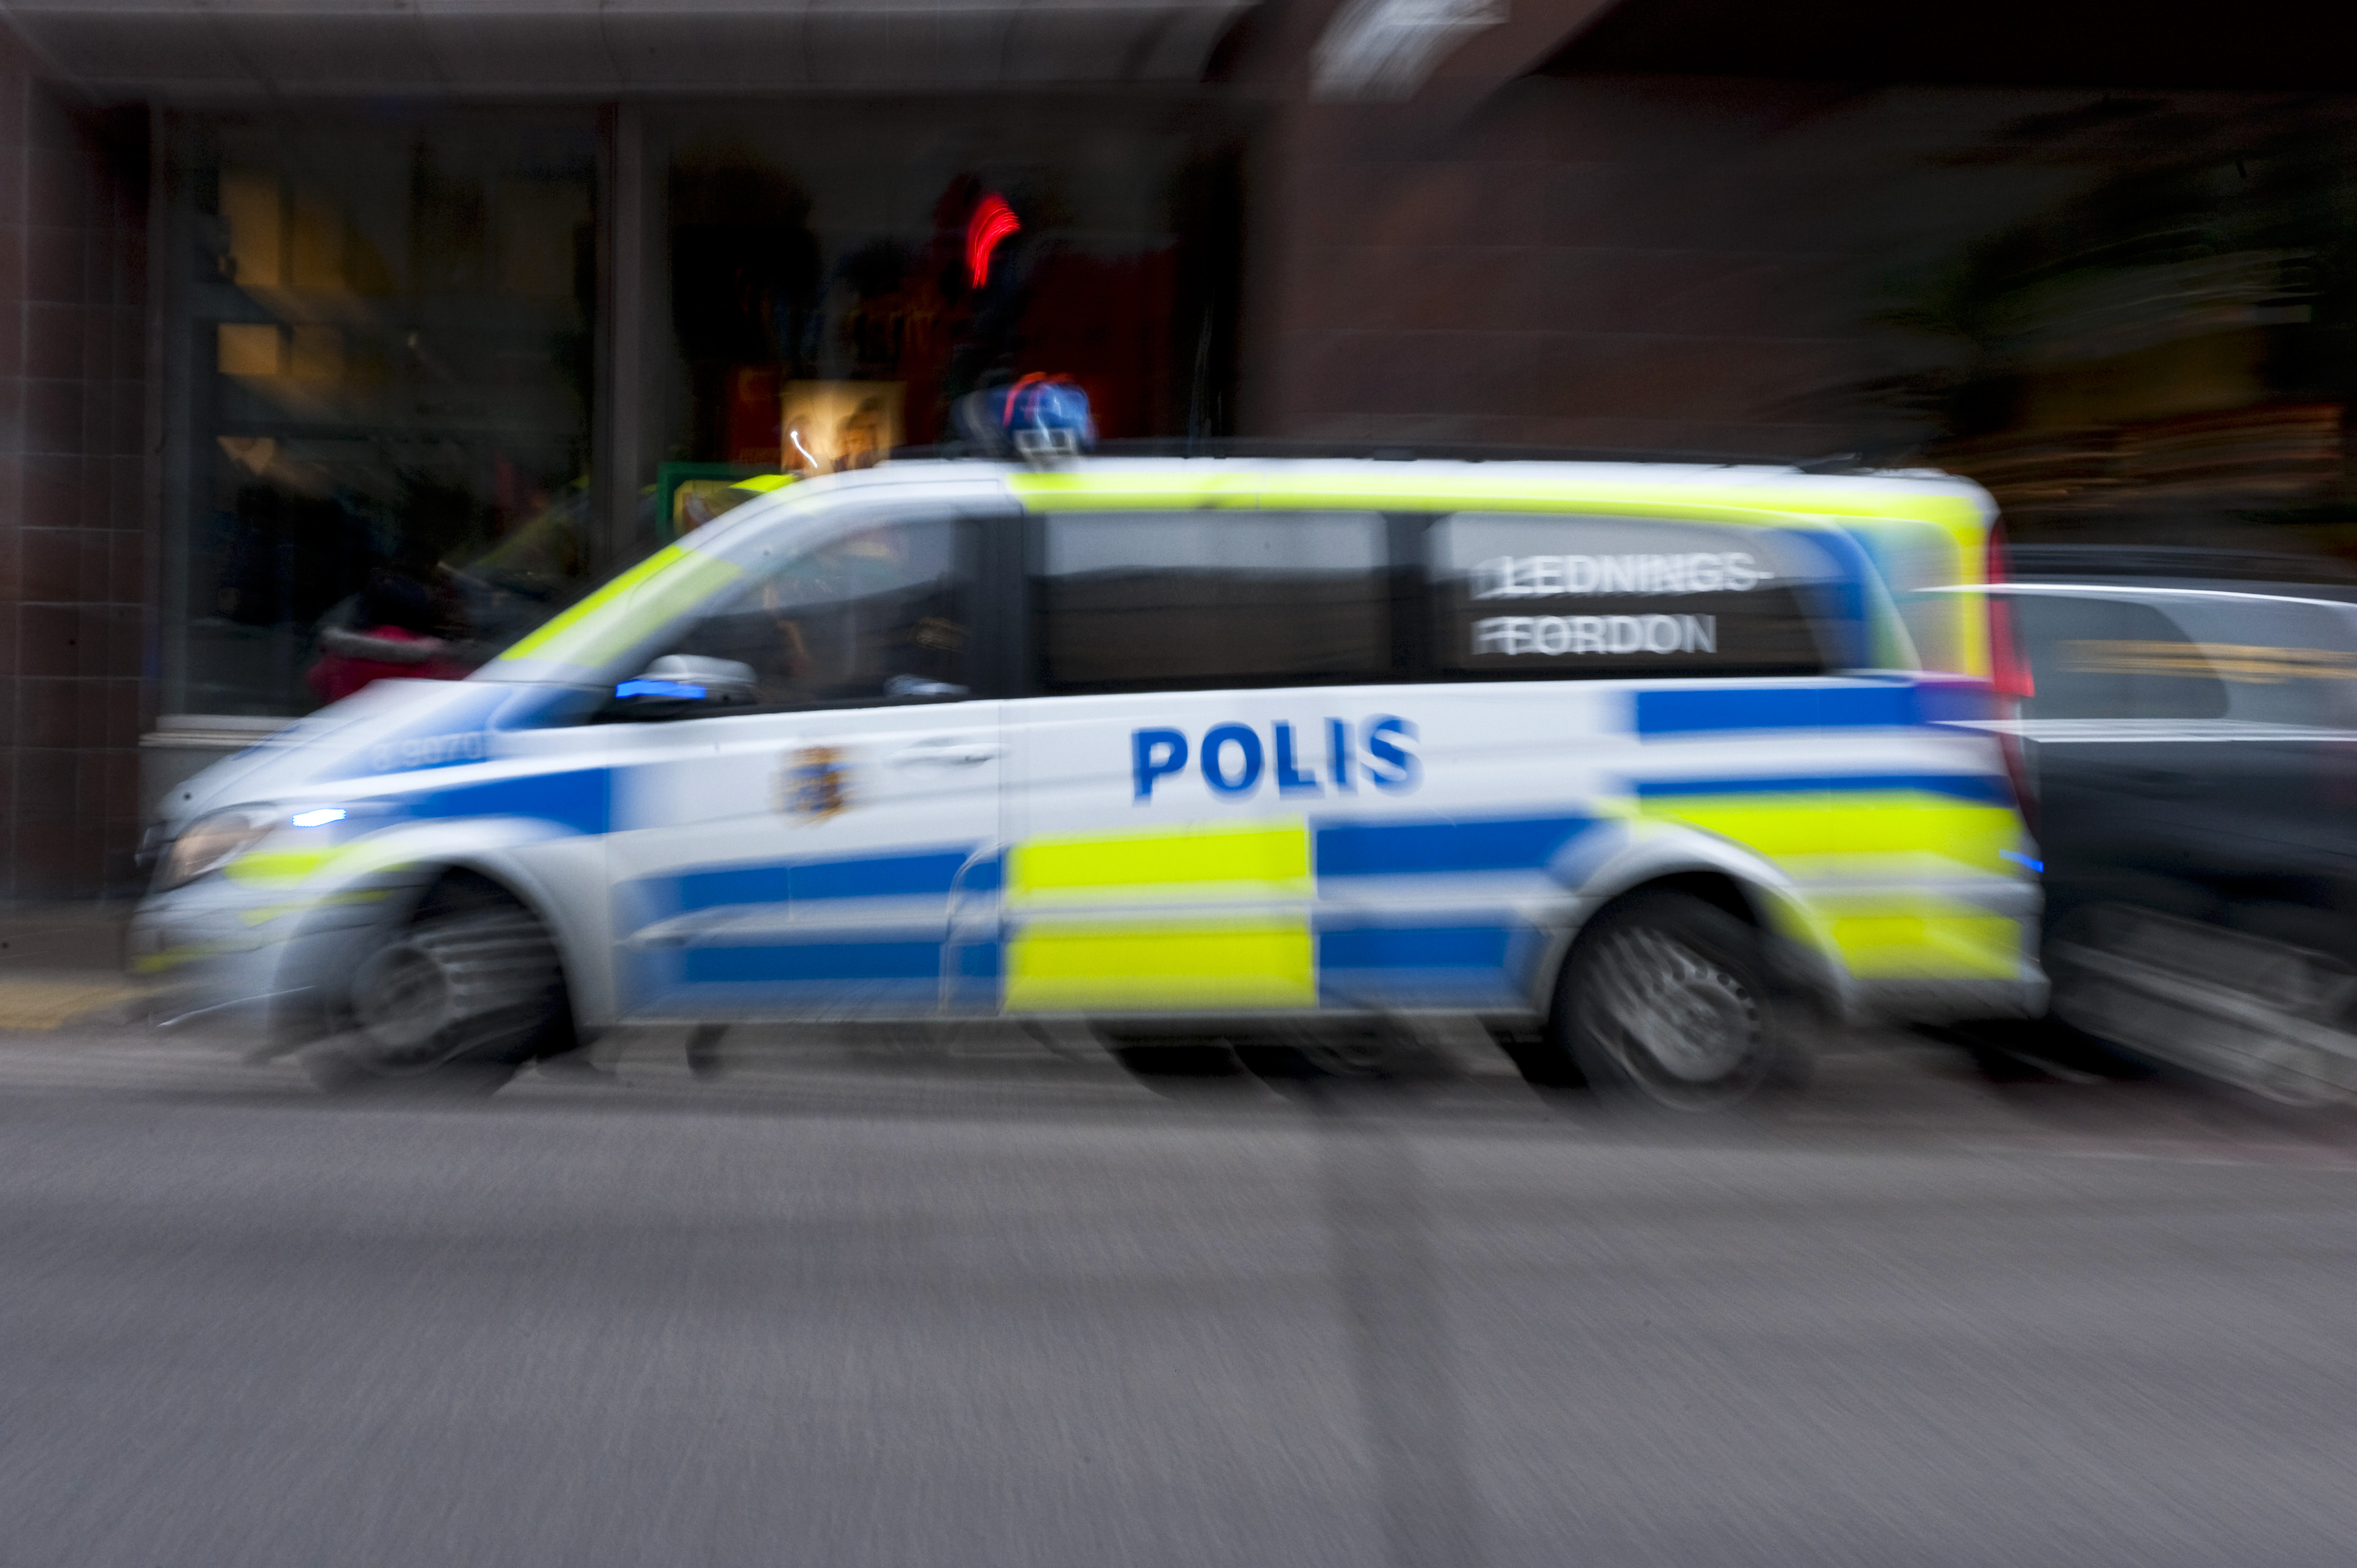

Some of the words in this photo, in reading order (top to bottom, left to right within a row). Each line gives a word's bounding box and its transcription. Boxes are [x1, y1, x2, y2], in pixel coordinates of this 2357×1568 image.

[1473, 553, 1774, 600] LEDNINGS-
[1471, 613, 1717, 656] FORDON
[1131, 713, 1424, 806] POLIS
